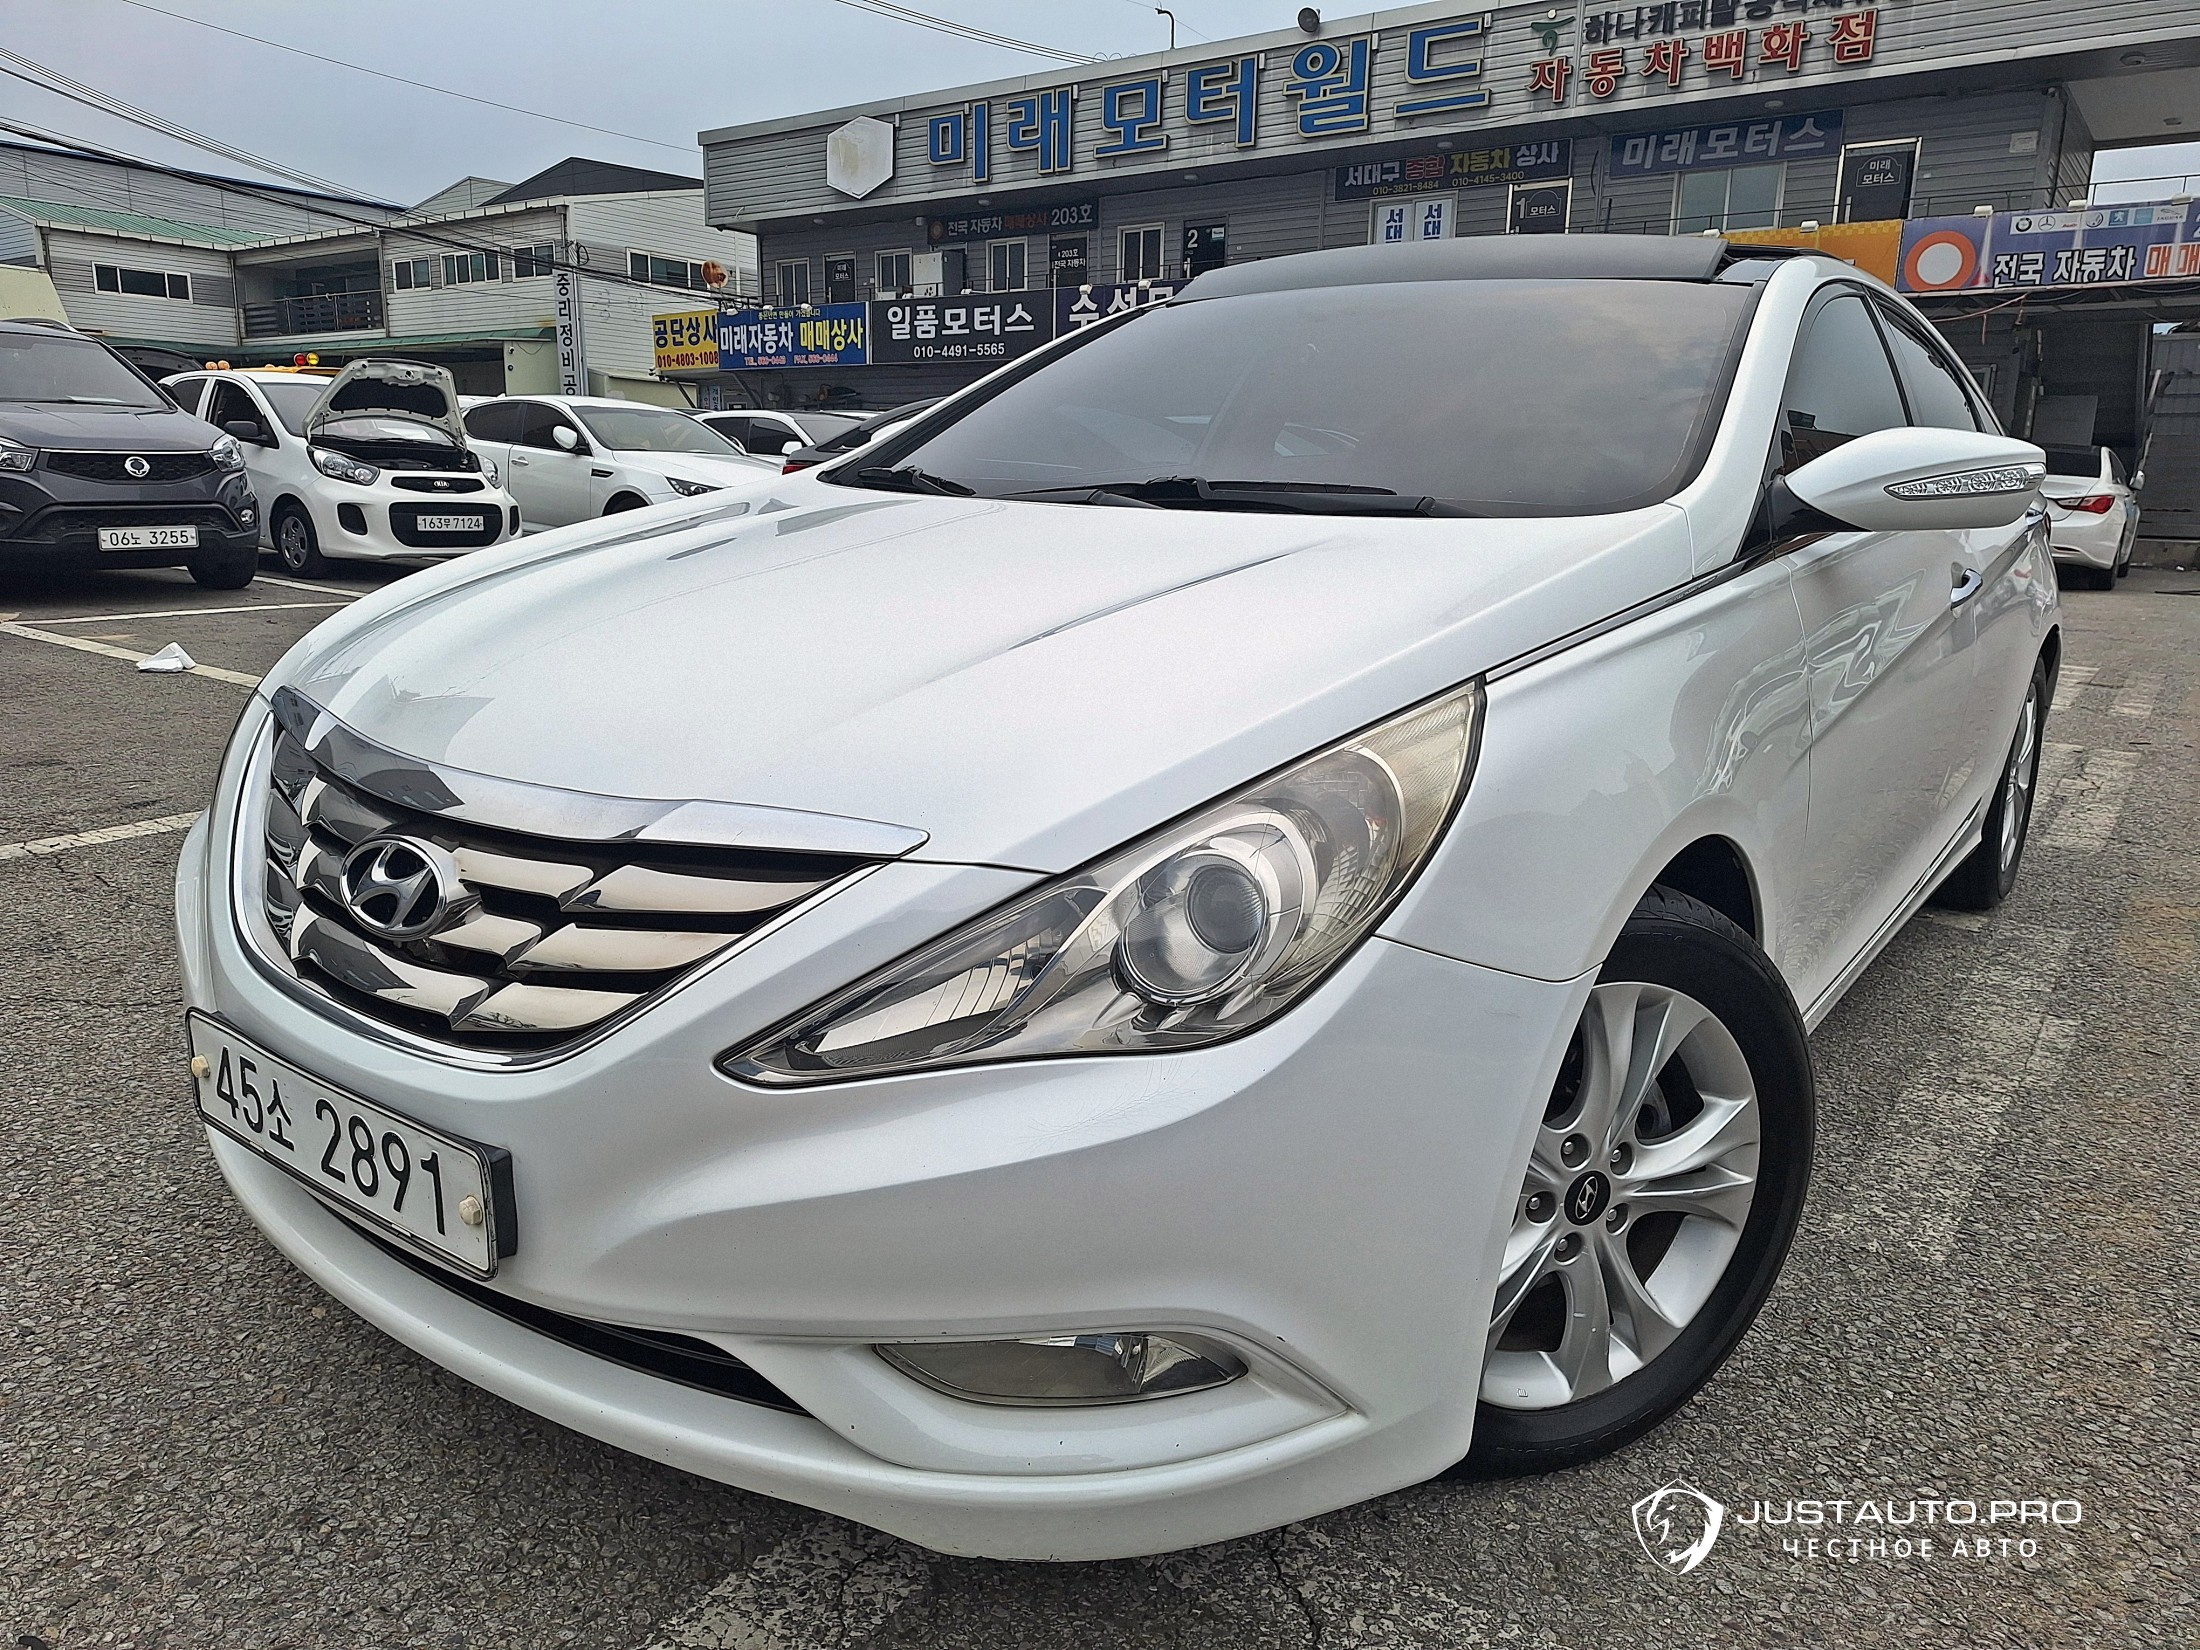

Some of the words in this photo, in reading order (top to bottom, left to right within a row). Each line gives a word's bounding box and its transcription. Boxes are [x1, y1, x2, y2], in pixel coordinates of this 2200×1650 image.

[1526, 8, 1879, 103] 자동차백화점
[927, 17, 1491, 184] 미래모터월드
[1622, 117, 1825, 169] 미래모터스
[1344, 161, 1400, 187] 서대구
[1404, 155, 1446, 181] 종합
[1450, 147, 1511, 175] 자동차
[1516, 141, 1559, 167] 상사
[1861, 171, 1895, 185] 모터스
[1869, 158, 1891, 171] 미래
[1373, 180, 1439, 196] 010-3821-8484
[1452, 171, 1524, 187] 010-4145-3400
[947, 221, 968, 237] 전국
[970, 216, 1002, 234] 자동차
[1051, 203, 1093, 226] 203호
[1424, 203, 1442, 240] 서대
[1516, 198, 1527, 219] 1
[1529, 205, 1557, 217] 모터스
[1187, 229, 1199, 249] 2
[1385, 208, 1404, 243] 서대
[1054, 260, 1067, 269] 전국
[1067, 258, 1086, 268] 자동차
[1061, 248, 1079, 258] 203호
[1993, 252, 2045, 289] 전국
[2053, 245, 2136, 284] 자동차
[835, 272, 850, 280] 모터스
[556, 273, 578, 396] 중리정비공
[654, 315, 718, 349] 공단상사
[719, 321, 794, 355] 미래자동차
[799, 317, 864, 351] 매매상사
[886, 303, 1035, 340] 일품모터스
[657, 350, 719, 369] 010-4803-1008
[913, 342, 1005, 359] 010-4491-5565
[454, 517, 481, 529] 7124
[109, 532, 142, 546] 06노
[149, 530, 189, 545] 3255
[215, 1044, 295, 1153] 45소
[314, 1098, 447, 1237] 2891
